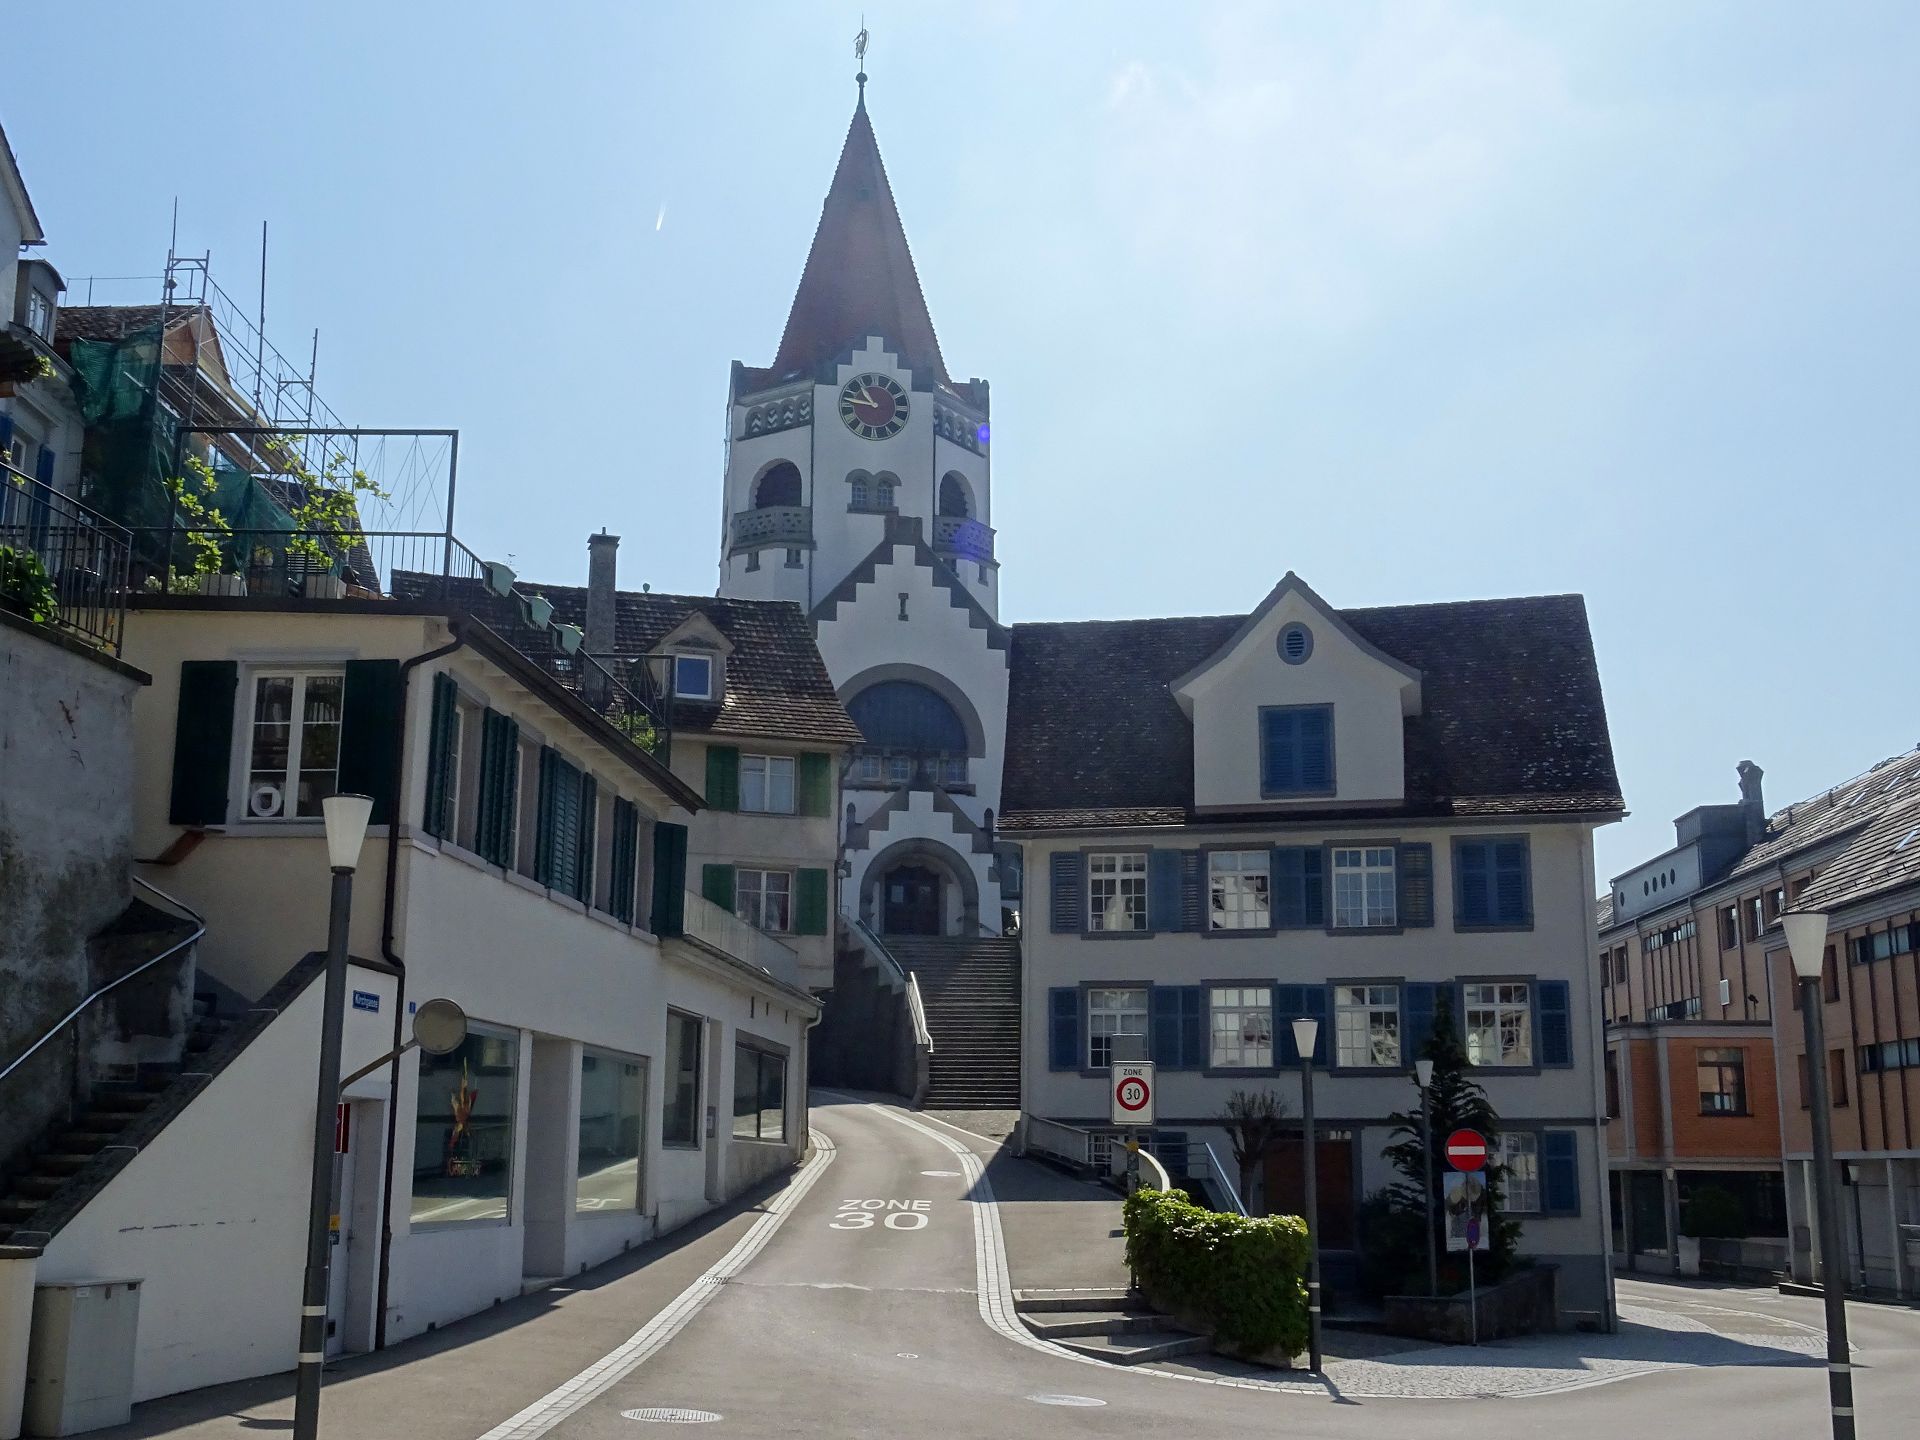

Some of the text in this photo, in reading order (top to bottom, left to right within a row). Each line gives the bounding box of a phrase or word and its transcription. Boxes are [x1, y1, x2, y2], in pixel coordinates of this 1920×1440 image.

[1126, 1088, 1140, 1100] 30
[838, 1199, 932, 1211] ZONE
[829, 1212, 929, 1230] 30
